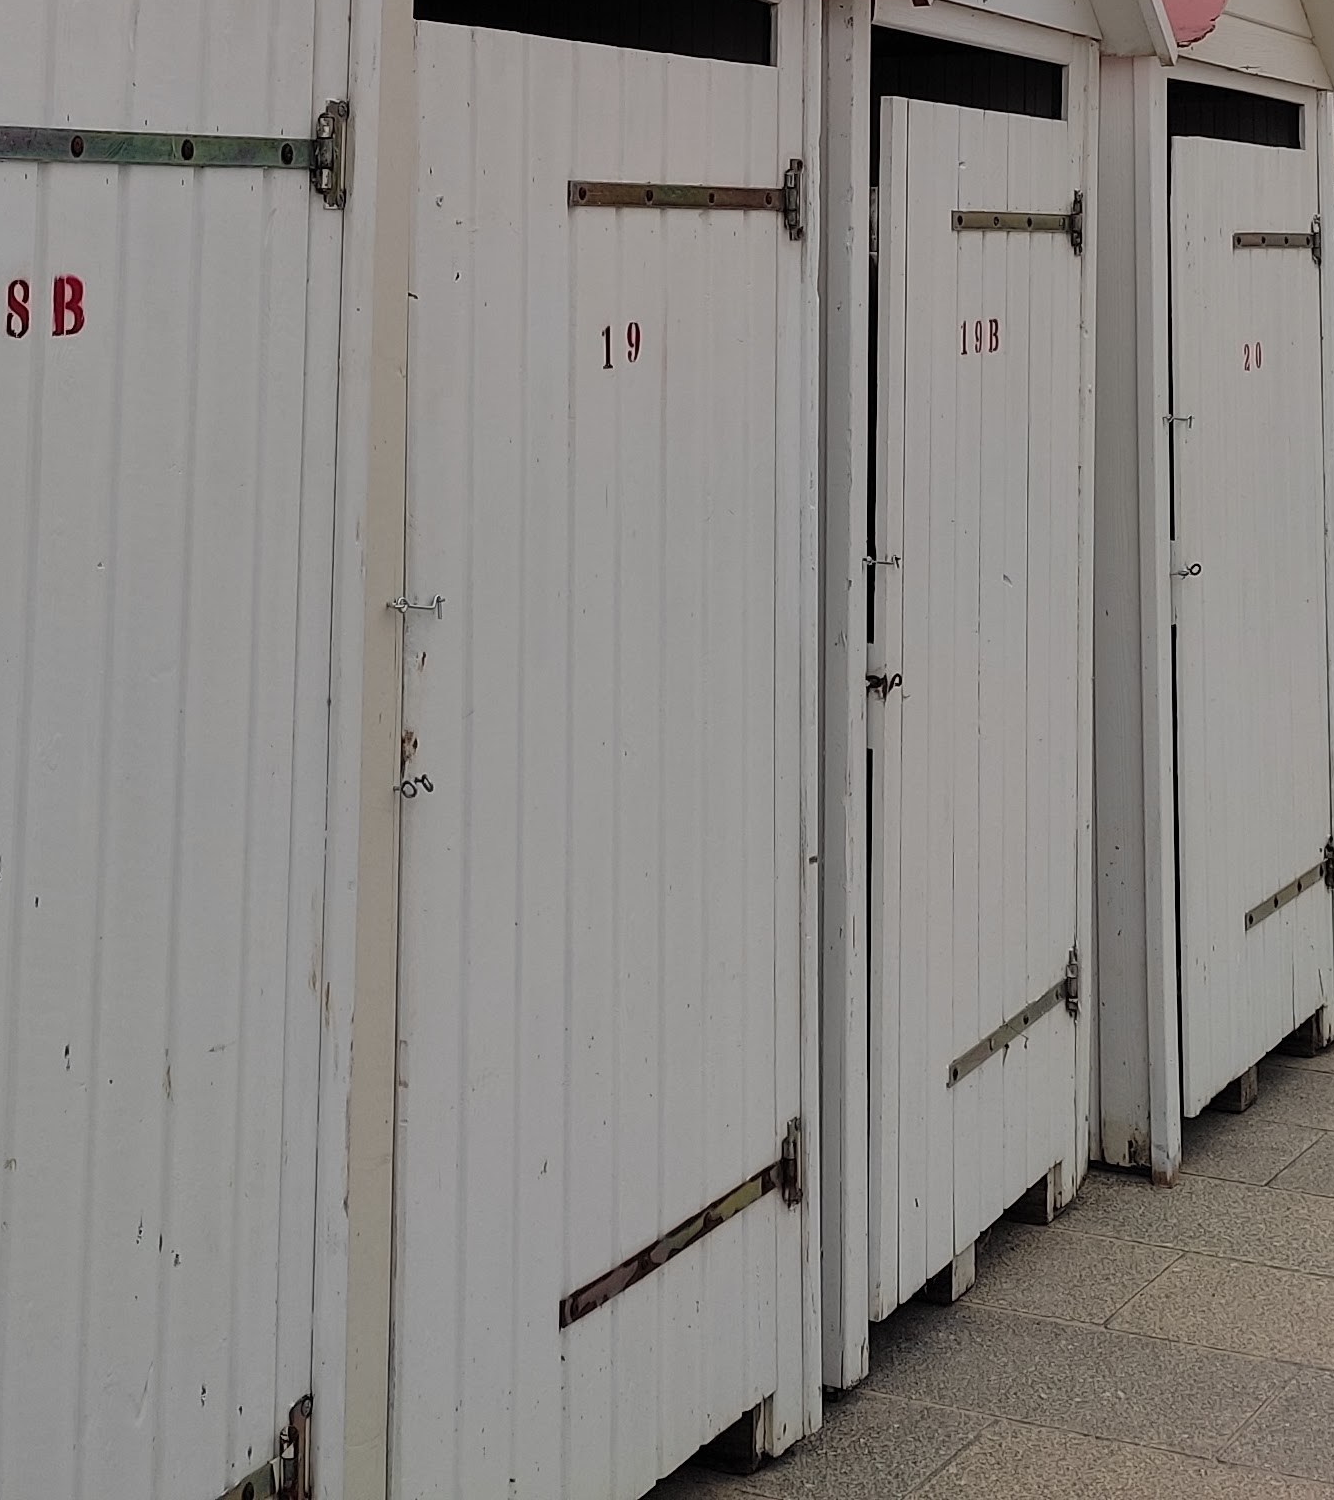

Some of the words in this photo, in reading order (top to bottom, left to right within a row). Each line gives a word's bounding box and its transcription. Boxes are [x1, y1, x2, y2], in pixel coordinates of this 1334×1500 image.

[601, 322, 641, 369] 19
[960, 318, 999, 356] 19B
[1244, 341, 1262, 371] 20
